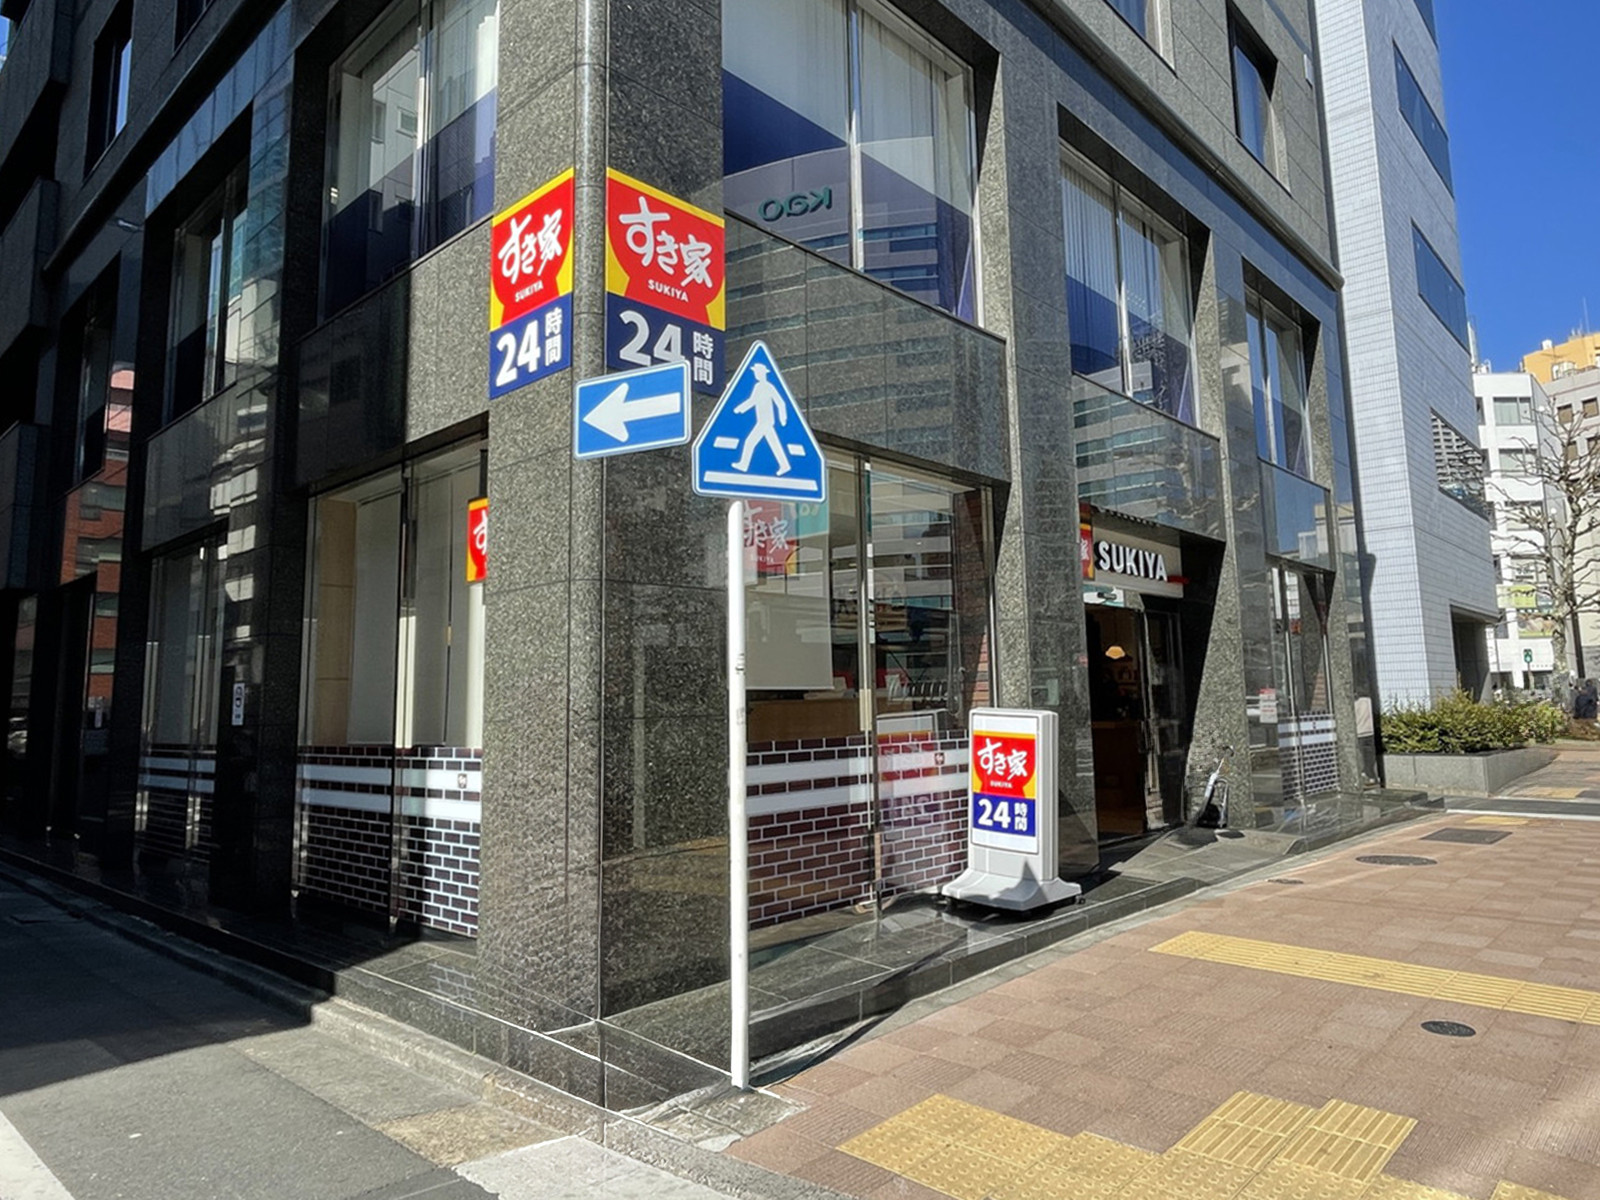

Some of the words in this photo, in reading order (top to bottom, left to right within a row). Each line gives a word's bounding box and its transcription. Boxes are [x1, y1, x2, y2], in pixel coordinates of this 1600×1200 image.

[498, 209, 563, 285] すき家
[619, 196, 713, 288] すき家
[515, 280, 544, 302] SUKIYA
[648, 279, 689, 302] SUKIYA
[496, 319, 541, 387] 24
[545, 307, 563, 366] 時間
[619, 310, 685, 366] 24
[693, 331, 713, 385] 時間
[1098, 540, 1168, 582] SUKIYA
[977, 738, 1028, 780] すき家
[978, 798, 1011, 828] 24
[1014, 802, 1028, 832] 時間
